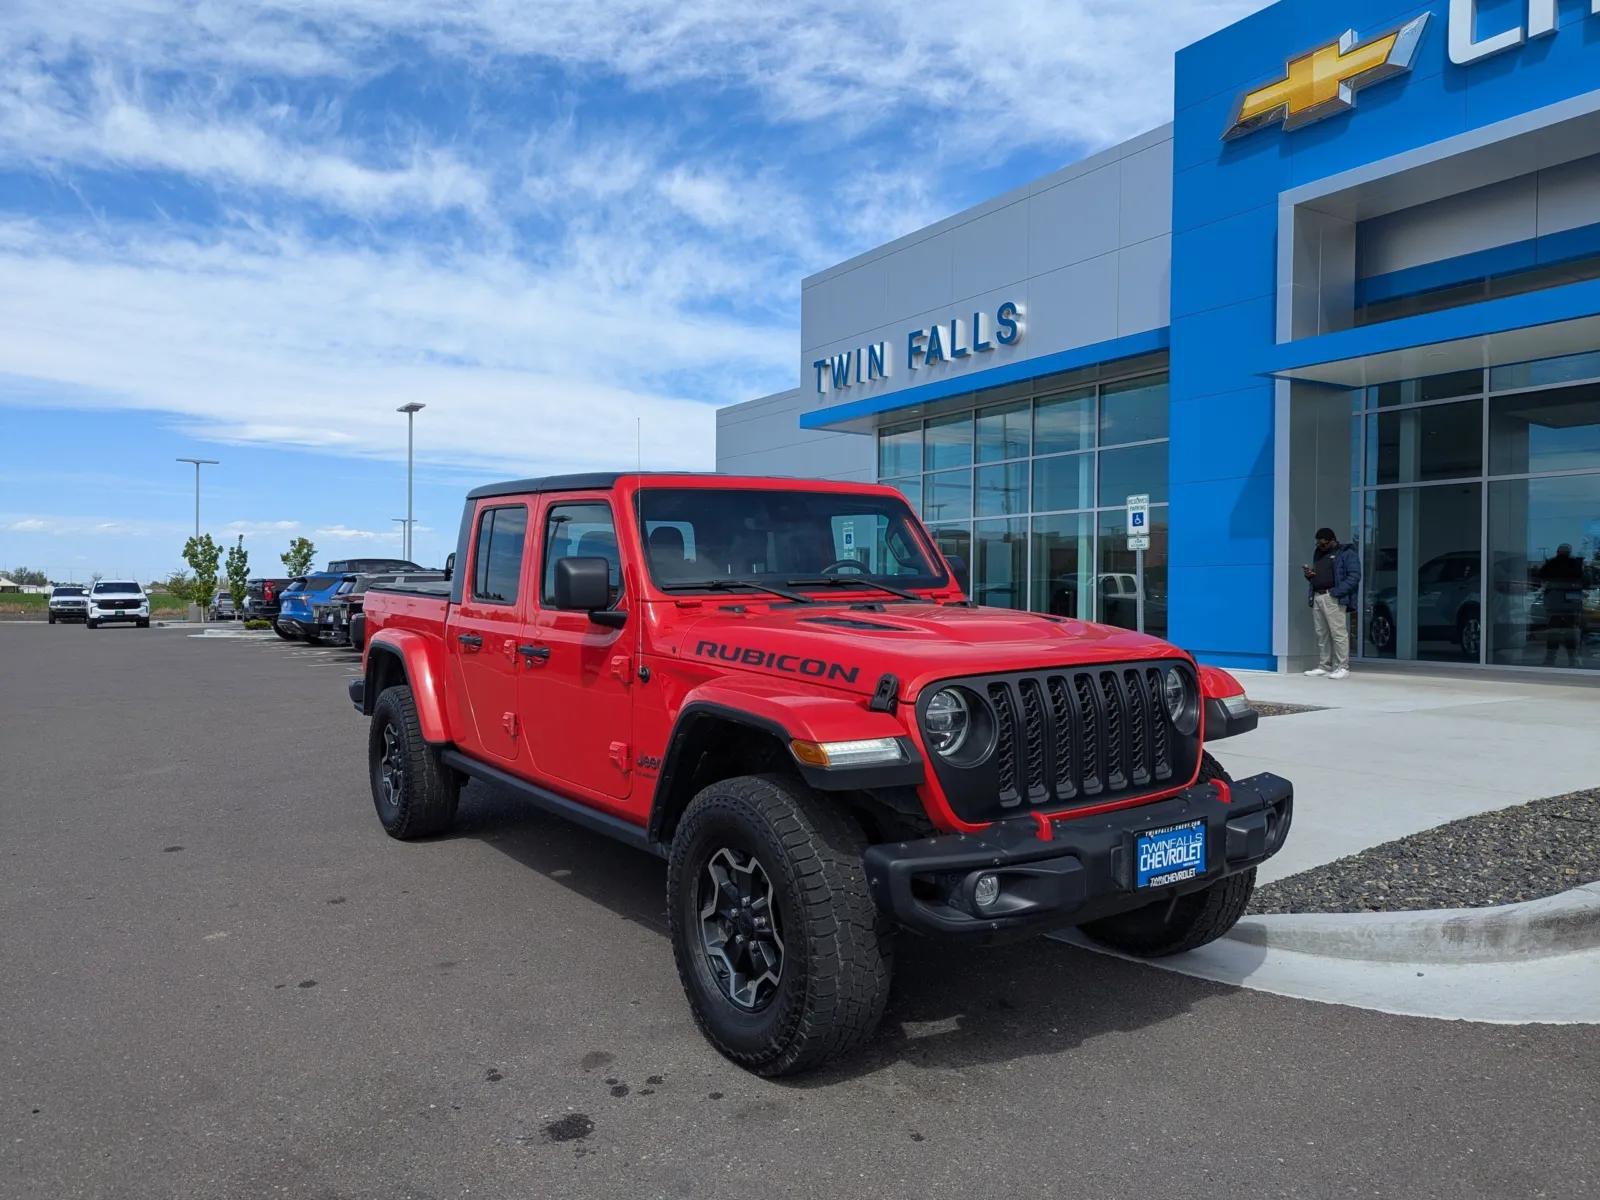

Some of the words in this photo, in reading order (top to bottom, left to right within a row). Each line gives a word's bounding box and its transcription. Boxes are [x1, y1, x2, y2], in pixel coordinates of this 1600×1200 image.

[813, 341, 890, 394] TWIN
[908, 301, 1023, 370] FALLS
[695, 640, 860, 683] RUBICON
[1140, 843, 1203, 872] CHEVROLET
